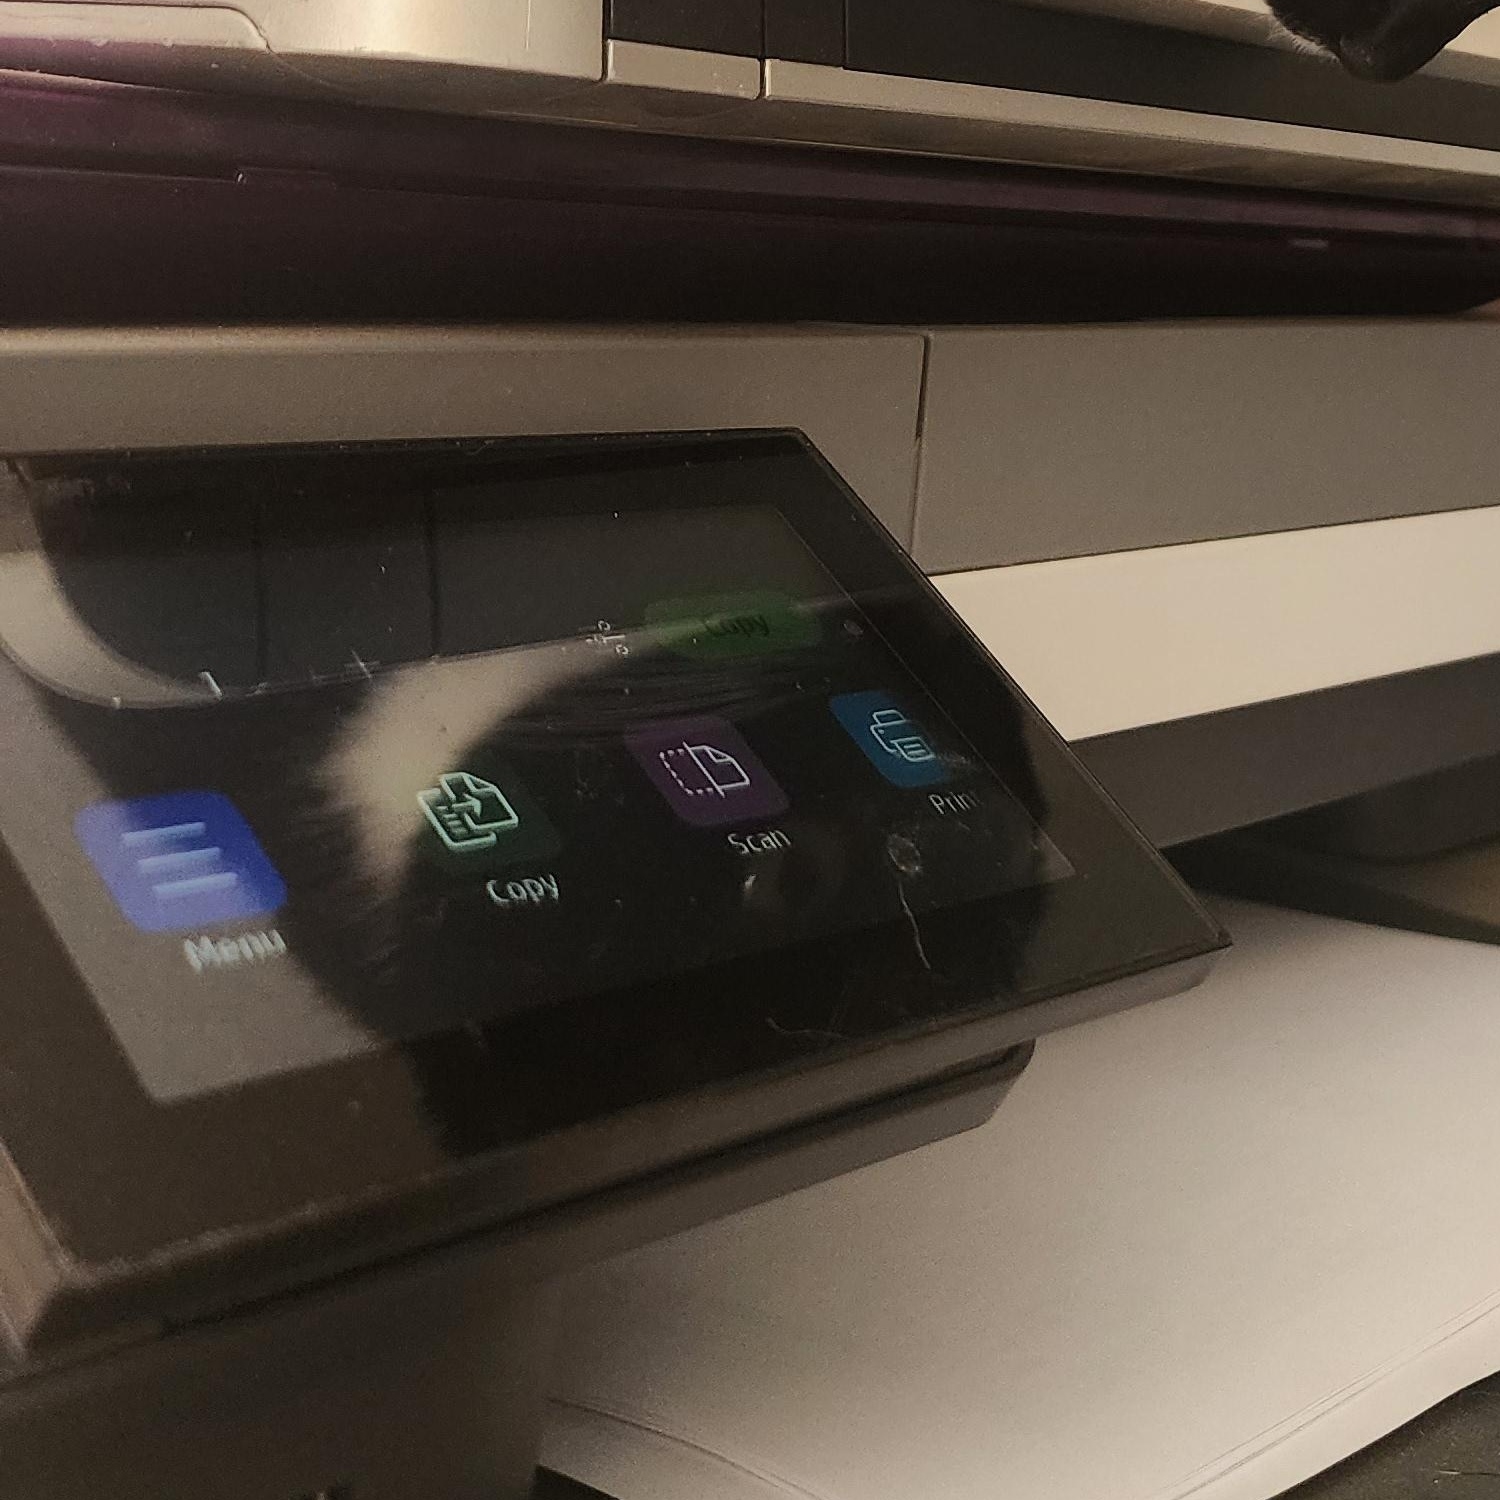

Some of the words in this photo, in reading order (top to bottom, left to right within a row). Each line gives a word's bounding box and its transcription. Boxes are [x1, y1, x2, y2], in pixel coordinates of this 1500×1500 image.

[727, 829, 792, 855] Scan
[485, 874, 560, 905] Copy
[183, 928, 288, 972] Menu
